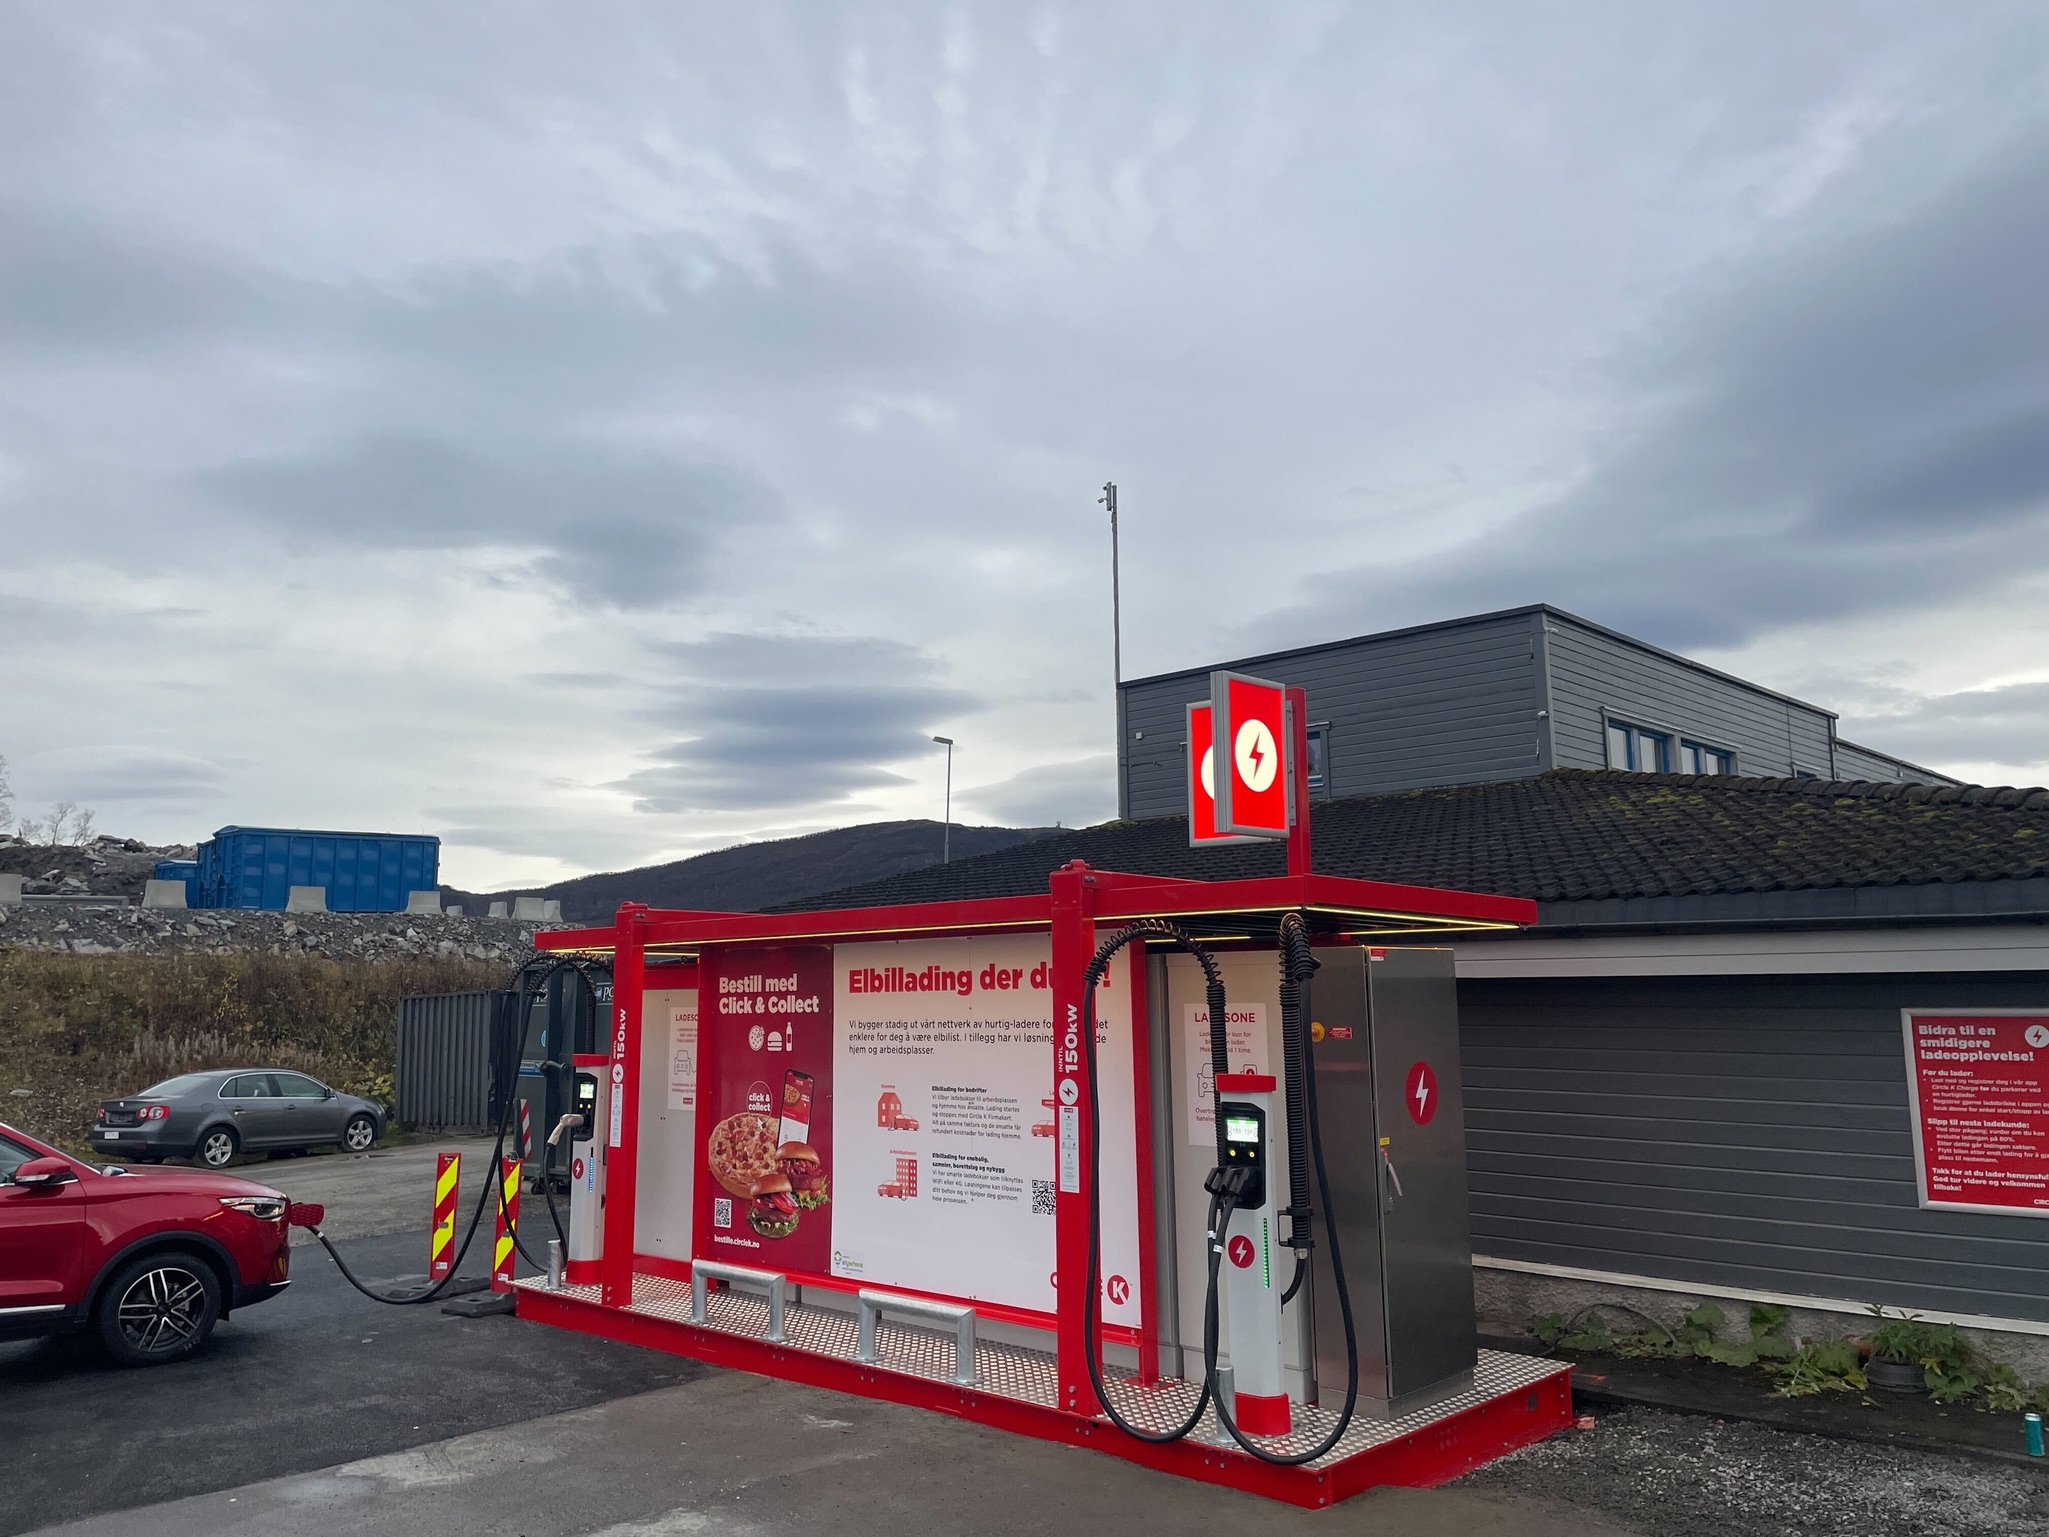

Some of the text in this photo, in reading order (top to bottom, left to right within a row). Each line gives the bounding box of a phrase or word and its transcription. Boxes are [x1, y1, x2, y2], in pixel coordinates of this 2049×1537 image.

[719, 973, 797, 994] Bestill med
[849, 962, 1053, 996] Elbillading der d
[719, 995, 819, 1014] Click & Collect
[1194, 1012, 1256, 1022] LASONE
[849, 1020, 856, 1028] Vi
[858, 1020, 883, 1031] bygger
[885, 1020, 908, 1031] stadig
[910, 1020, 918, 1028] ut
[920, 1020, 935, 1028] vårt
[937, 1020, 971, 1028] nettverk
[984, 1020, 1040, 1031] hurtig-ladere
[1918, 1025, 1996, 1036] Bidra til en
[616, 1008, 626, 1060] 150kW
[850, 1033, 875, 1041] enklere
[877, 1033, 887, 1042] for
[889, 1033, 903, 1044] deg
[906, 1033, 910, 1042] å
[933, 1033, 961, 1042] elbilist.
[969, 1034, 995, 1044] tillegg
[998, 1034, 1011, 1042] har
[1014, 1034, 1021, 1042] vi
[1024, 1034, 1054, 1045] løsning
[1064, 1004, 1078, 1074] 150kW
[1920, 1038, 1990, 1049] smidigere
[849, 1045, 934, 1056] hjem og arbeidsplasser.
[1921, 1050, 2034, 1062] ladeopplevelse!
[748, 1093, 770, 1102] click &
[748, 1102, 770, 1112] collect
[1927, 1118, 1948, 1127] Slipp
[1983, 1120, 2030, 1129] ladekunde:
[2006, 1172, 2049, 1181] hensynsful
[2000, 1180, 2046, 1188] velkommen
[714, 1234, 760, 1248] bestille.circlek.no
